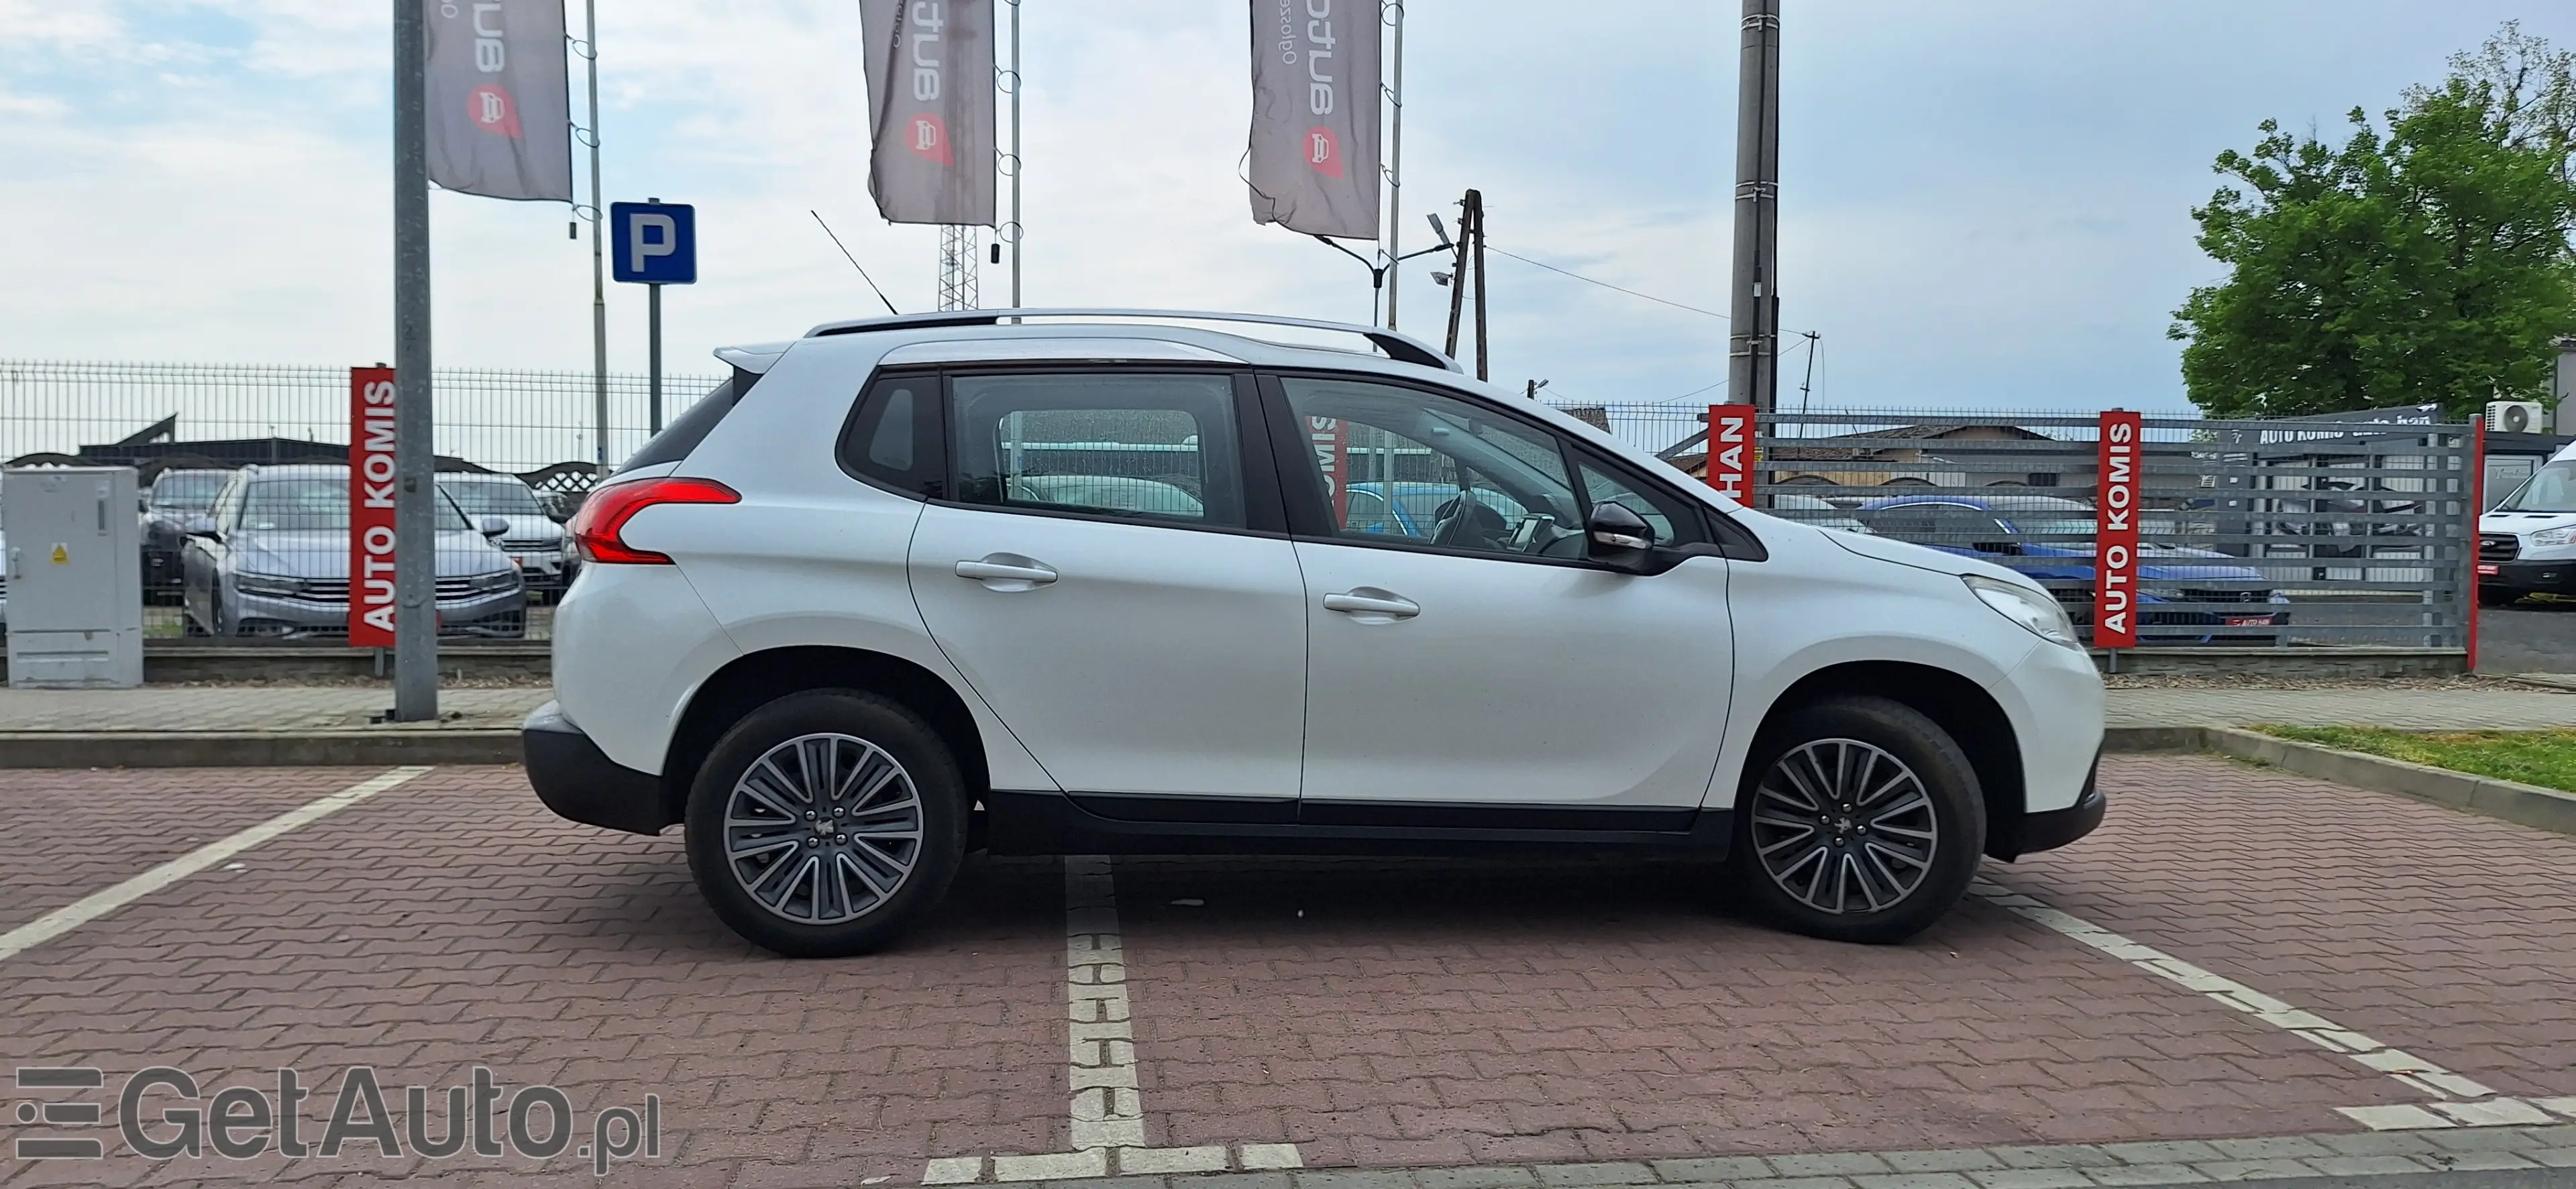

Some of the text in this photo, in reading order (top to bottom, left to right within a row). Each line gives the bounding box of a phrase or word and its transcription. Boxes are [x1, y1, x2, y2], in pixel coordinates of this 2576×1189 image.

[629, 213, 676, 273] P
[364, 381, 396, 632] AUTO KOMIS
[1719, 417, 1743, 498] HAN
[2104, 423, 2132, 634] AUTO KOMIS
